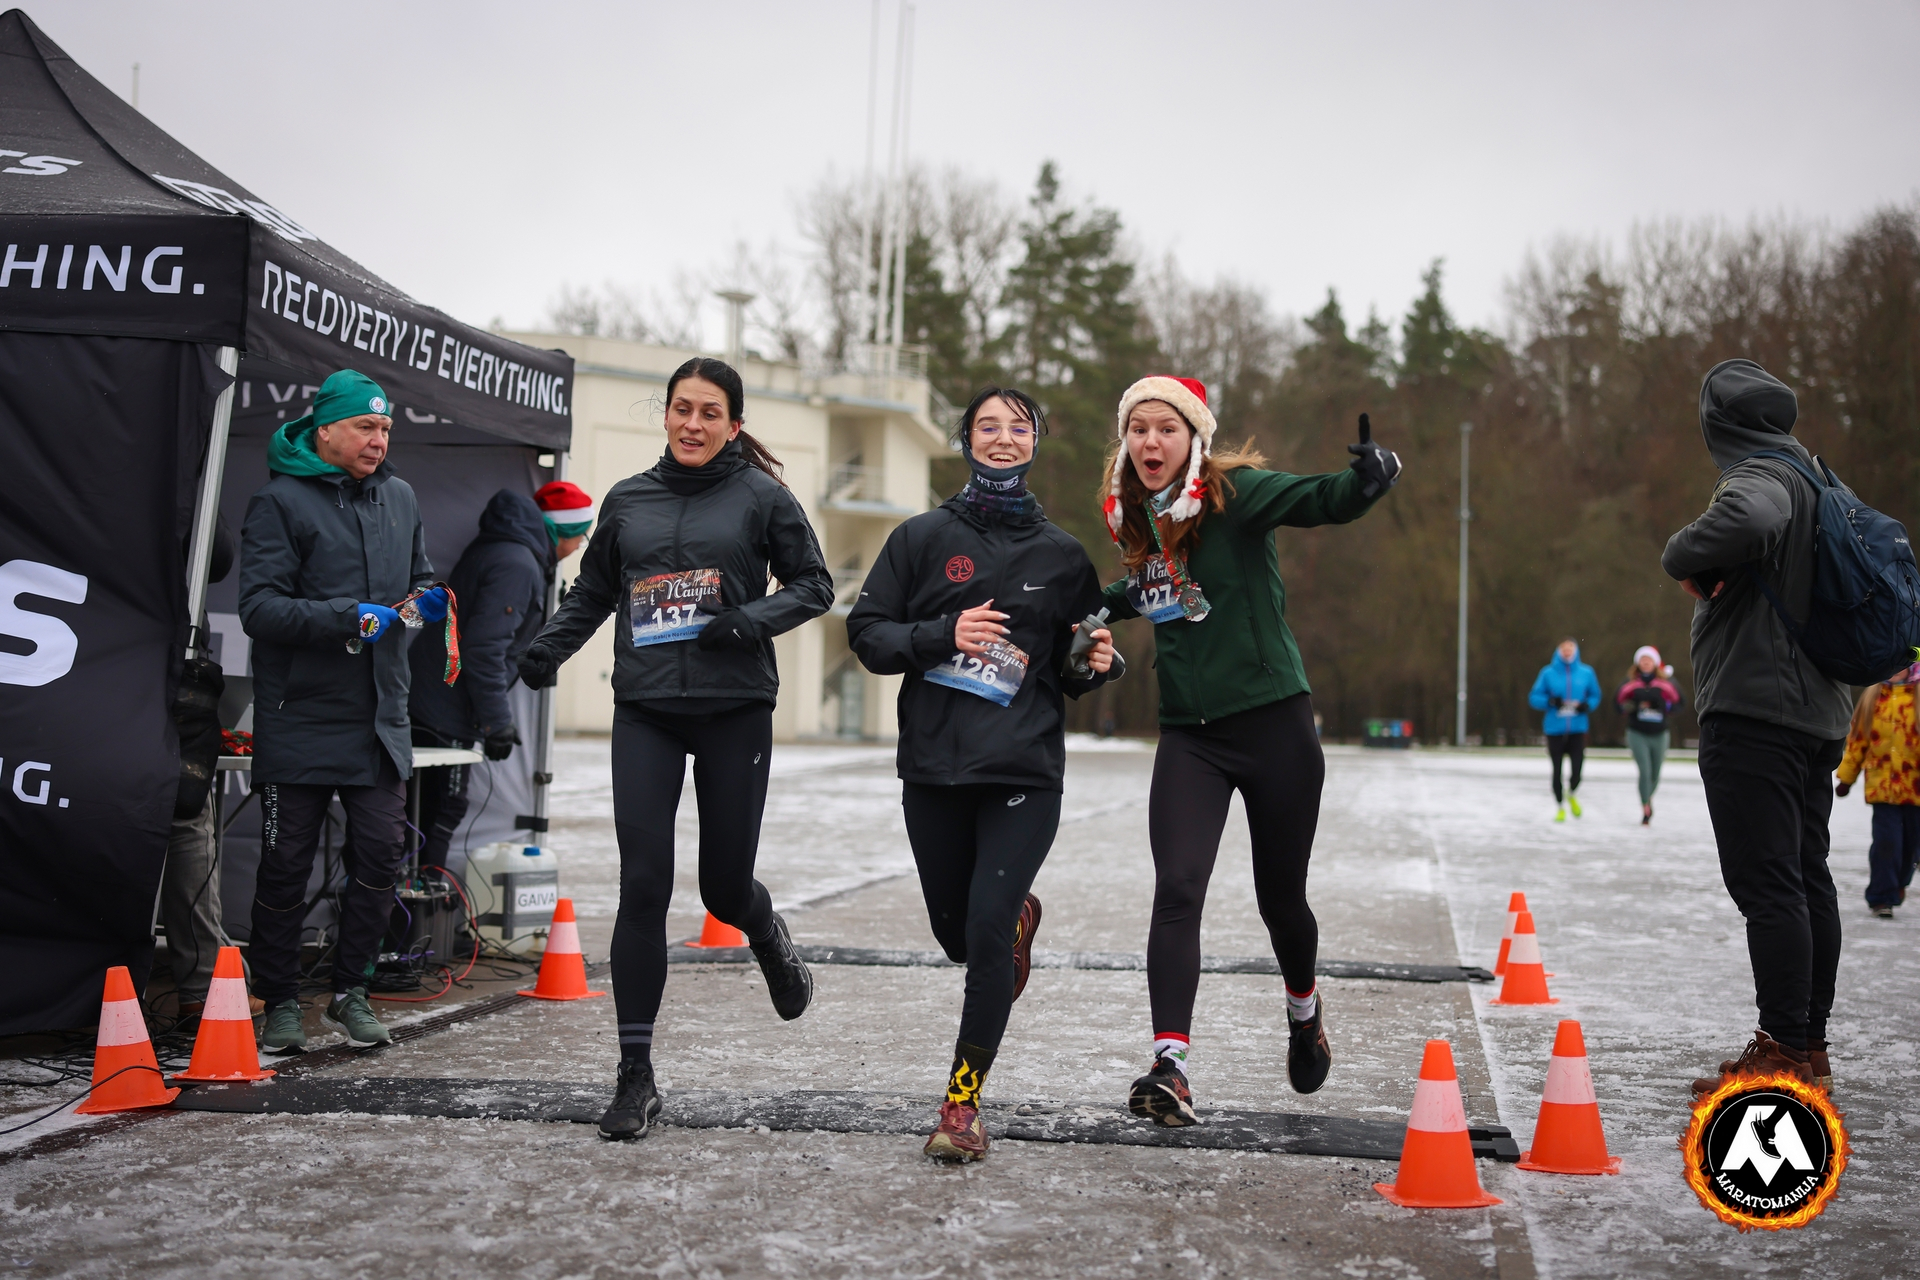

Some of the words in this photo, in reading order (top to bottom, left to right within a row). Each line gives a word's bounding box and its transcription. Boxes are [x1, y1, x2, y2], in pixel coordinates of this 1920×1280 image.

[0, 244, 205, 295] HING.
[261, 260, 408, 361] RECOVERY
[408, 324, 436, 371] IS
[437, 334, 568, 416] EVERYTHING.
[658, 579, 718, 602] Naujus
[1140, 583, 1172, 612] 127
[652, 603, 697, 630] 137
[951, 652, 999, 685] 126
[0, 757, 70, 808] G.
[517, 892, 556, 907] GAIVA
